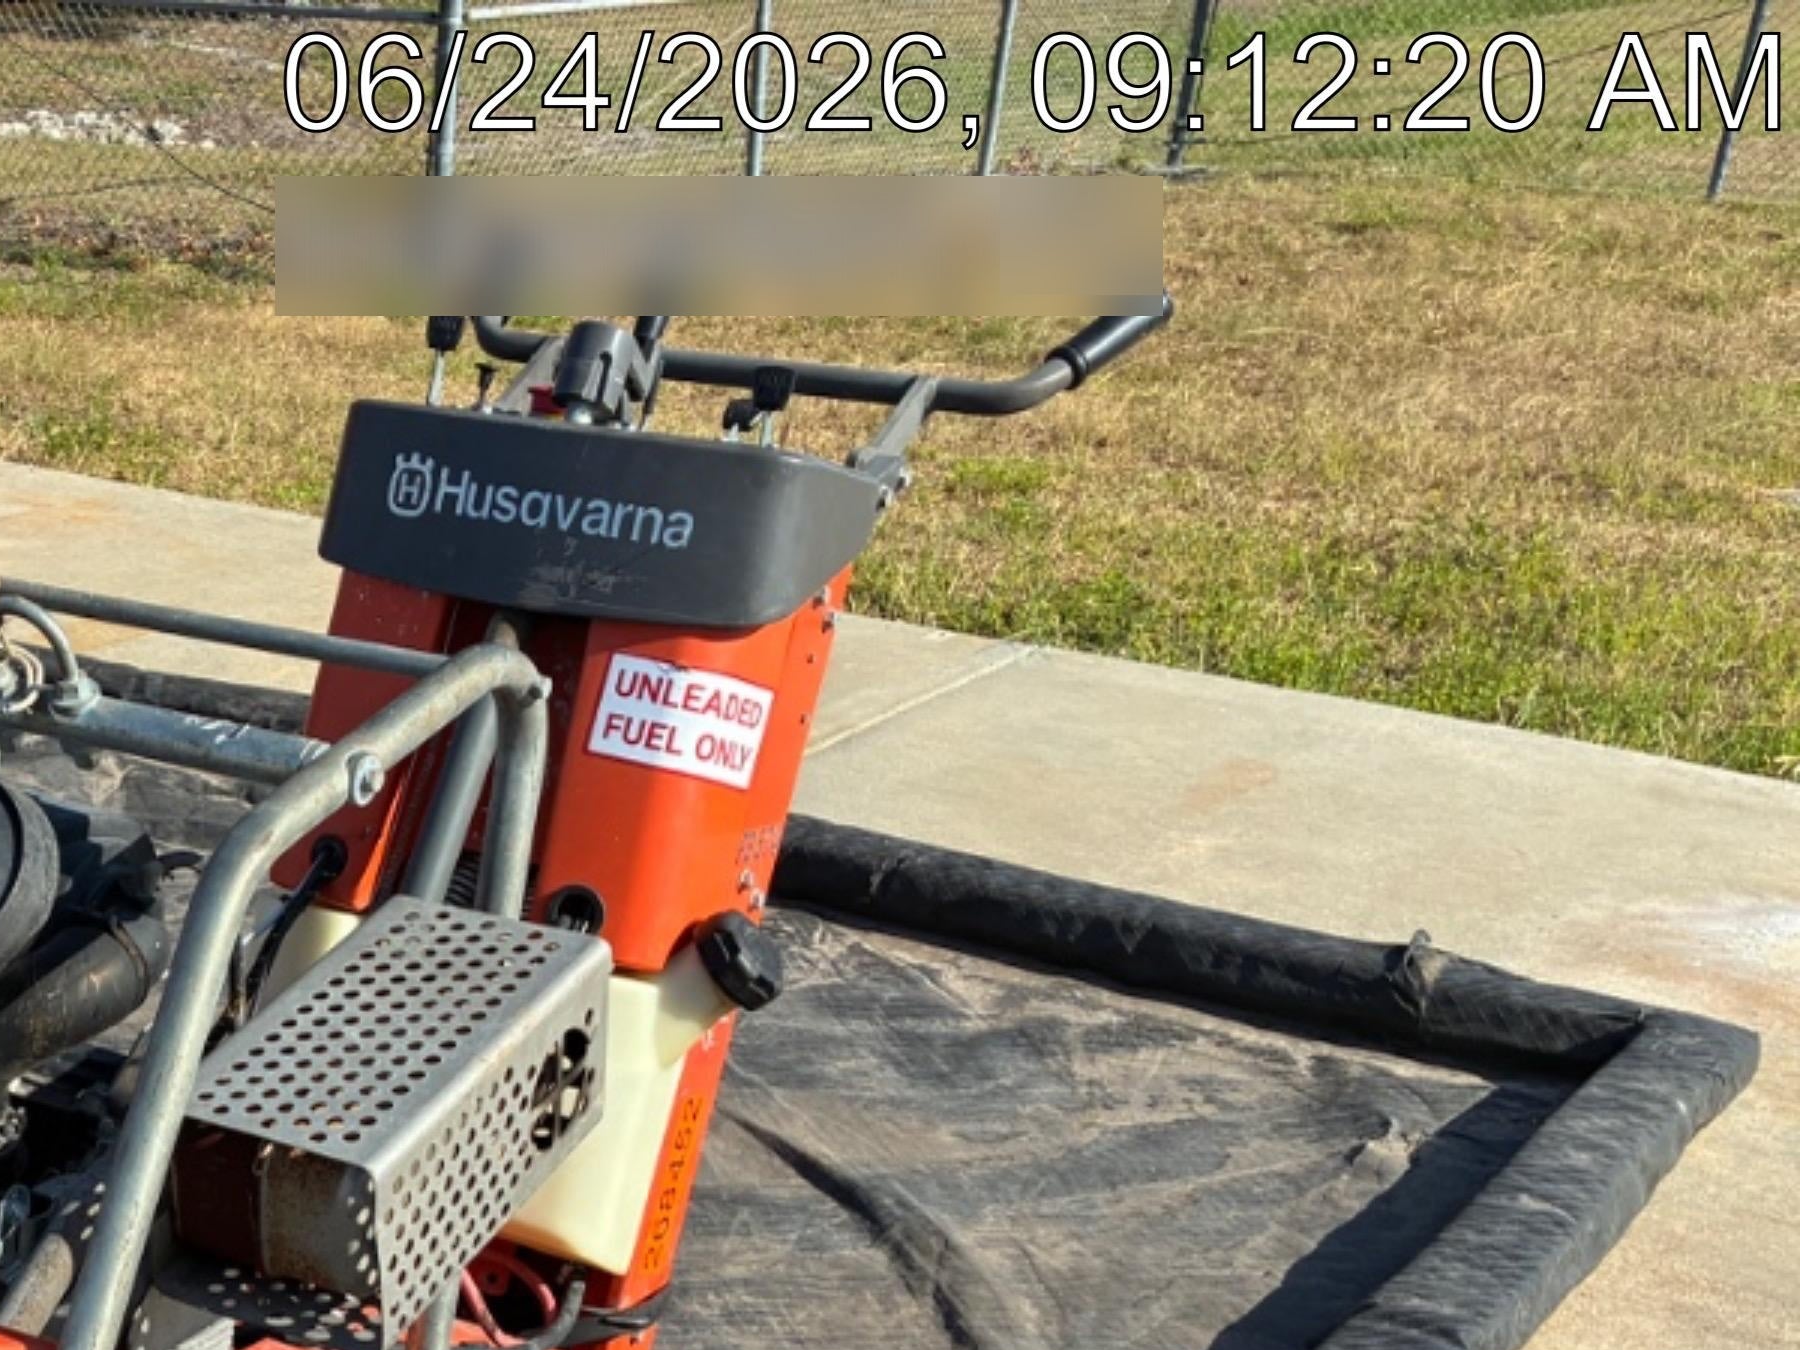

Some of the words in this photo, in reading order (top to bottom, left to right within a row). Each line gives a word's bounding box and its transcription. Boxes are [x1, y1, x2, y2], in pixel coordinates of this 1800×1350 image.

[433, 466, 695, 549] Husqvarna
[614, 667, 763, 730] UNLEADED
[601, 712, 683, 757] FUEL
[695, 733, 753, 772] ONLY
